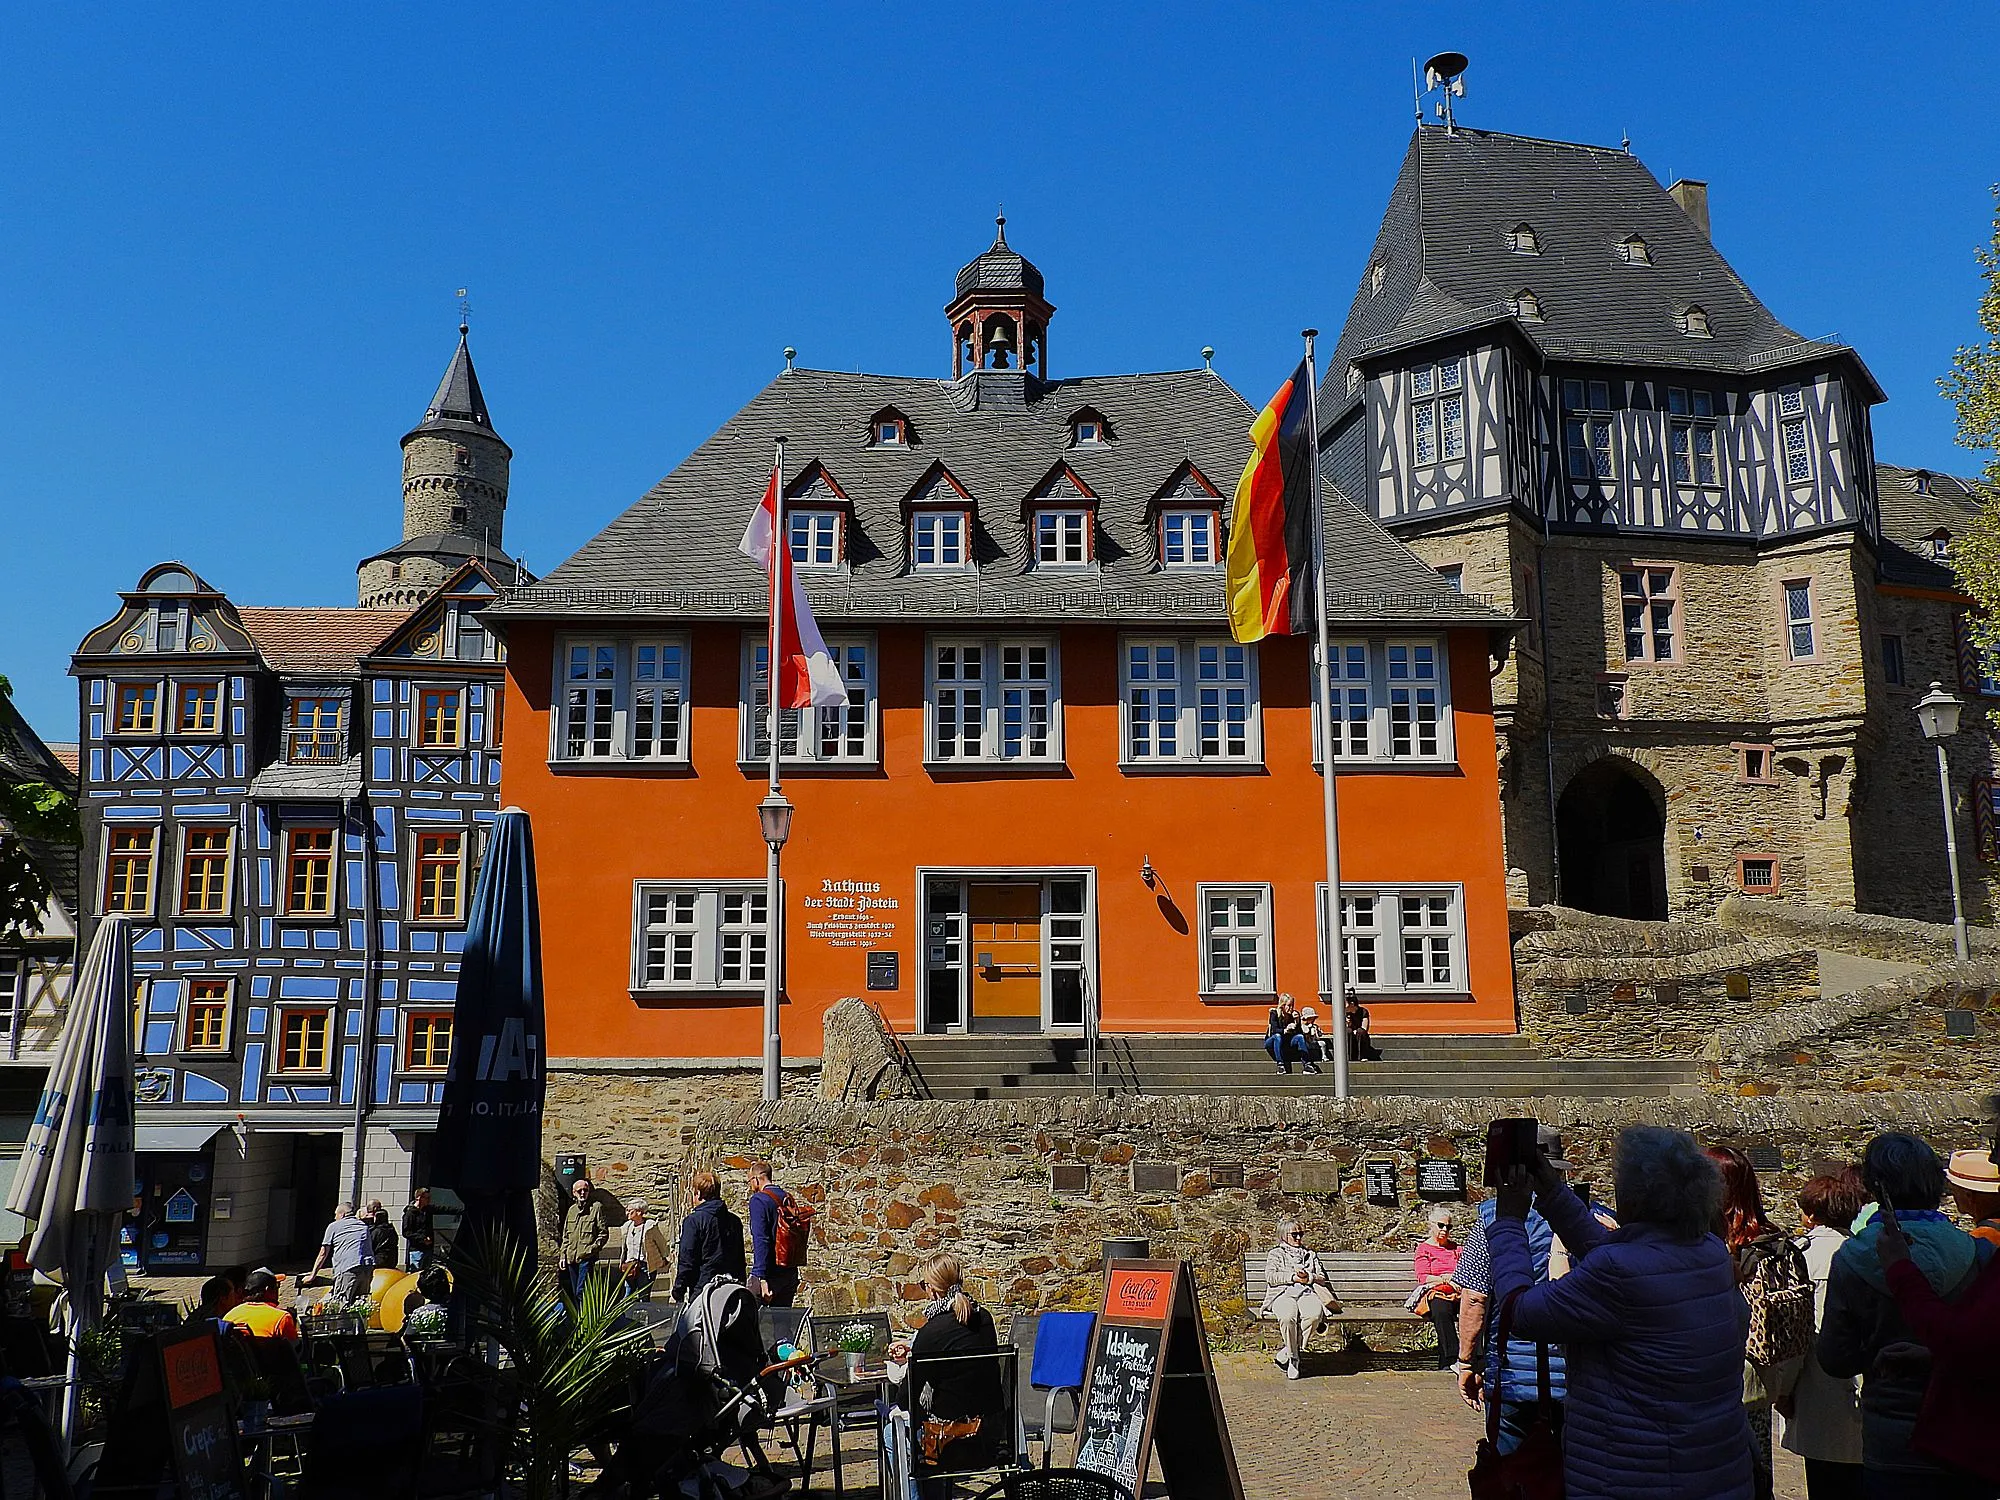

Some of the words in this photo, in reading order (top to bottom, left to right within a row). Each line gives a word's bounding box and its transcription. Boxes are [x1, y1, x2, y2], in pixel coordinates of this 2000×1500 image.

[821, 879, 881, 895] Rathaus
[804, 896, 823, 908] der
[825, 896, 855, 908] Stadt
[1106, 1330, 1149, 1358] Idsteiner
